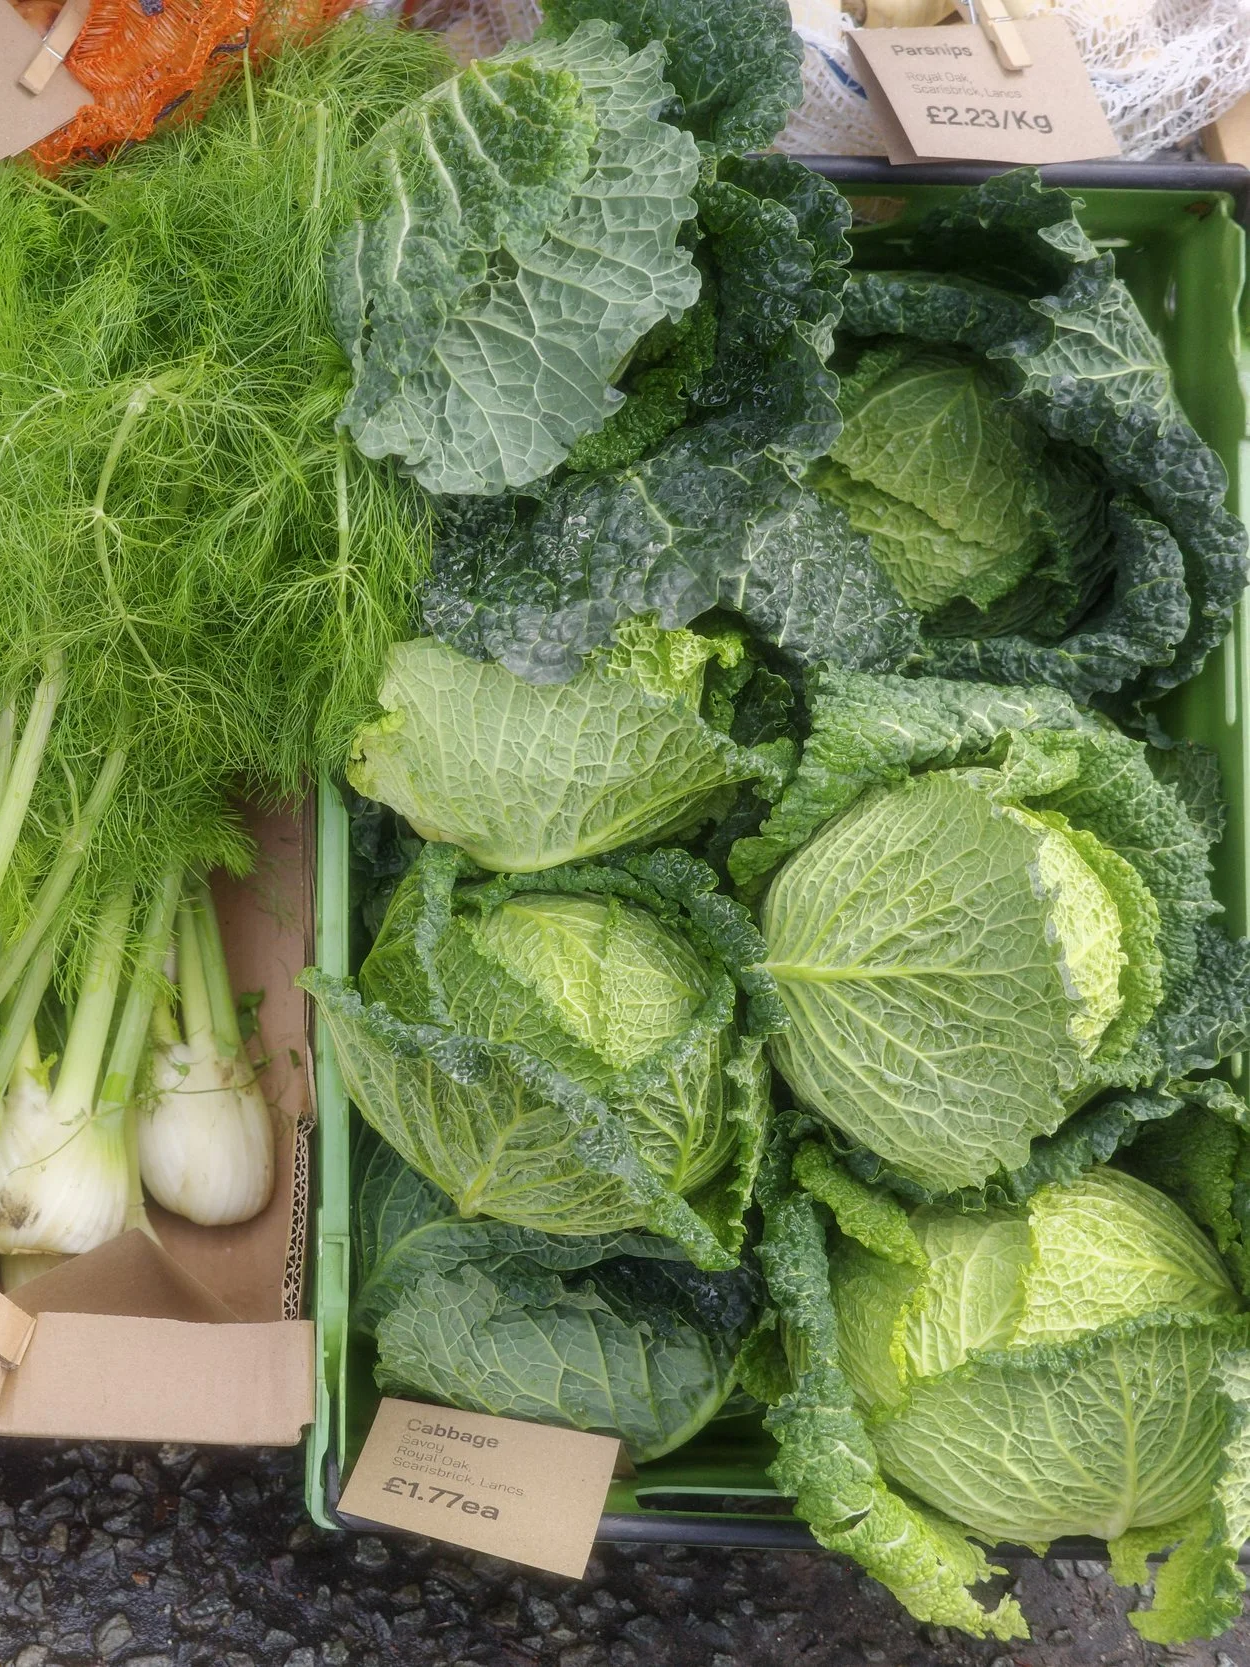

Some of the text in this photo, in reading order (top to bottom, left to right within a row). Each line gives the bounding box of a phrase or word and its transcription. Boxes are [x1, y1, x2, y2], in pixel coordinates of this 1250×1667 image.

[890, 44, 973, 58] Parsnips
[905, 71, 943, 84] Royal
[985, 87, 1022, 99] Lancs
[926, 105, 1053, 134] £2.23/Kg
[401, 1433, 445, 1454] Savoy
[406, 1418, 500, 1449] Cabbage
[396, 1445, 472, 1472] Royal Oak,
[391, 1456, 525, 1497] Scarisbrick, Lancs
[381, 1476, 500, 1521] £1.77ea
